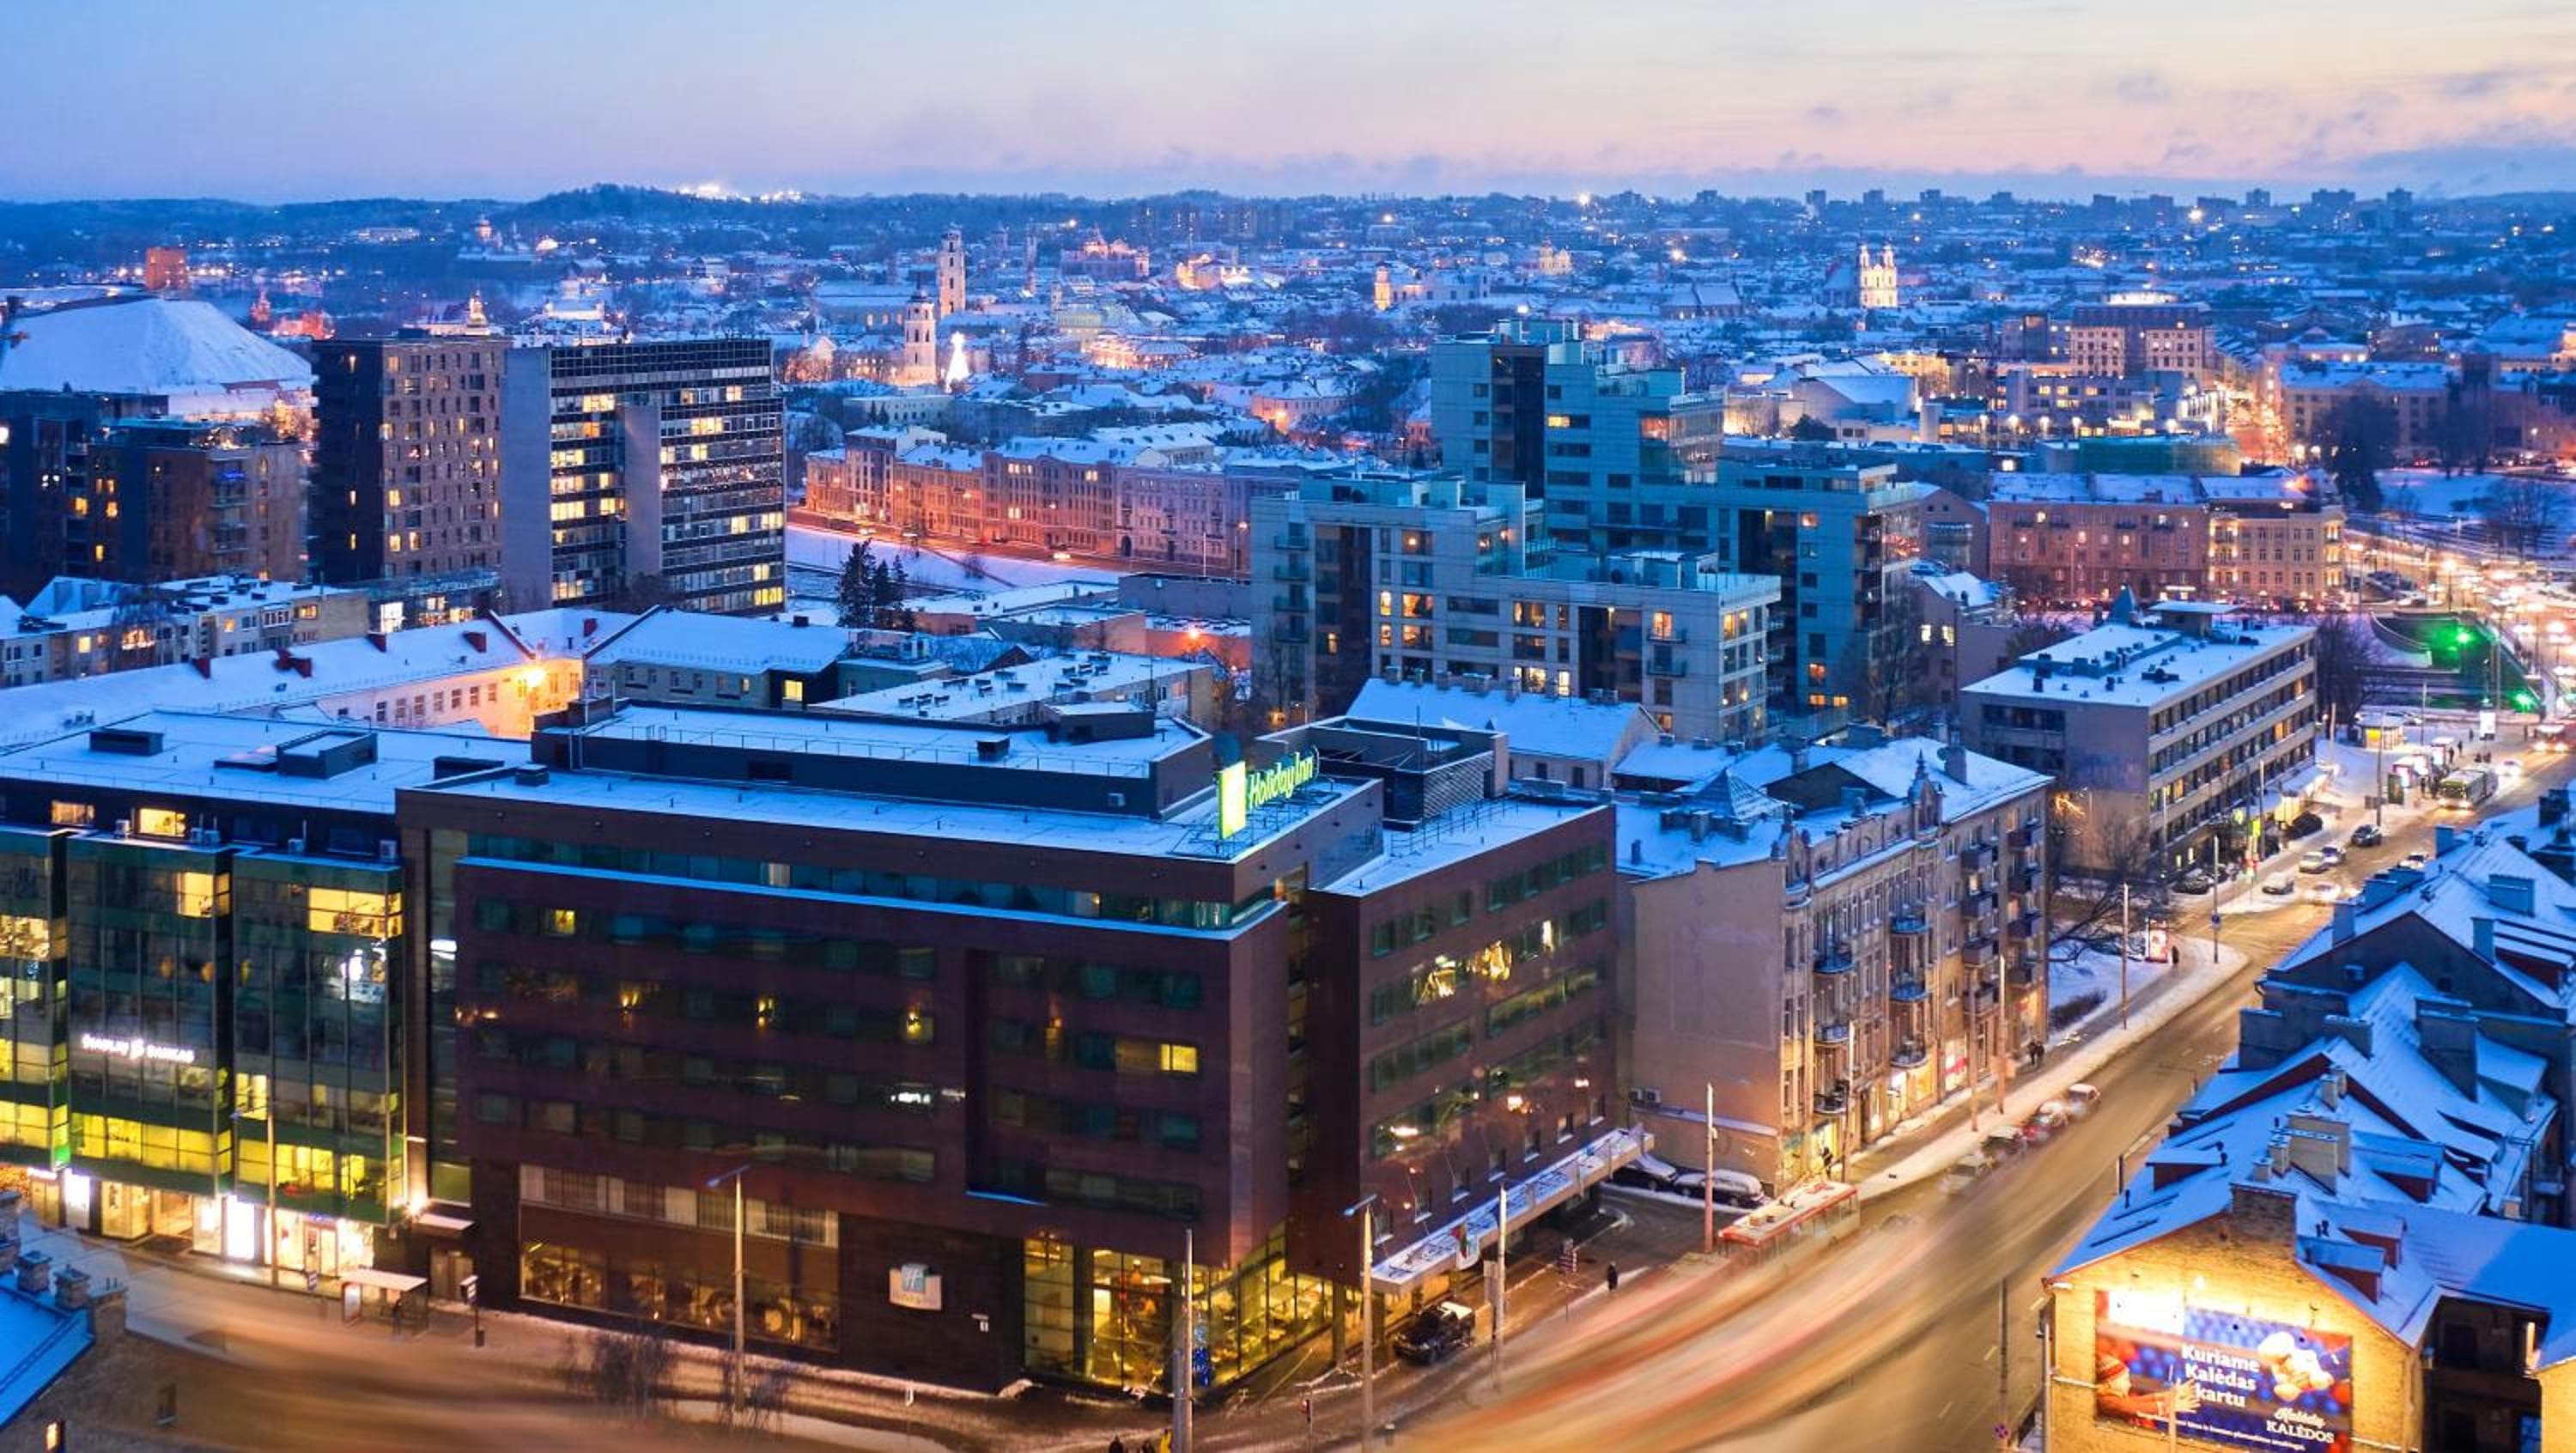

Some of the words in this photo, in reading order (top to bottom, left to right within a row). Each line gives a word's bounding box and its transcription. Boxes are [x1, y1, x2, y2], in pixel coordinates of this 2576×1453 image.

[1249, 762, 1295, 811] Holiday
[1295, 751, 1313, 786] Inn
[2181, 1343, 2260, 1373] Kuriame
[2185, 1363, 2257, 1390] Kalėdas
[2195, 1382, 2245, 1408] kartu
[2266, 1420, 2335, 1444] KALĖDOS
